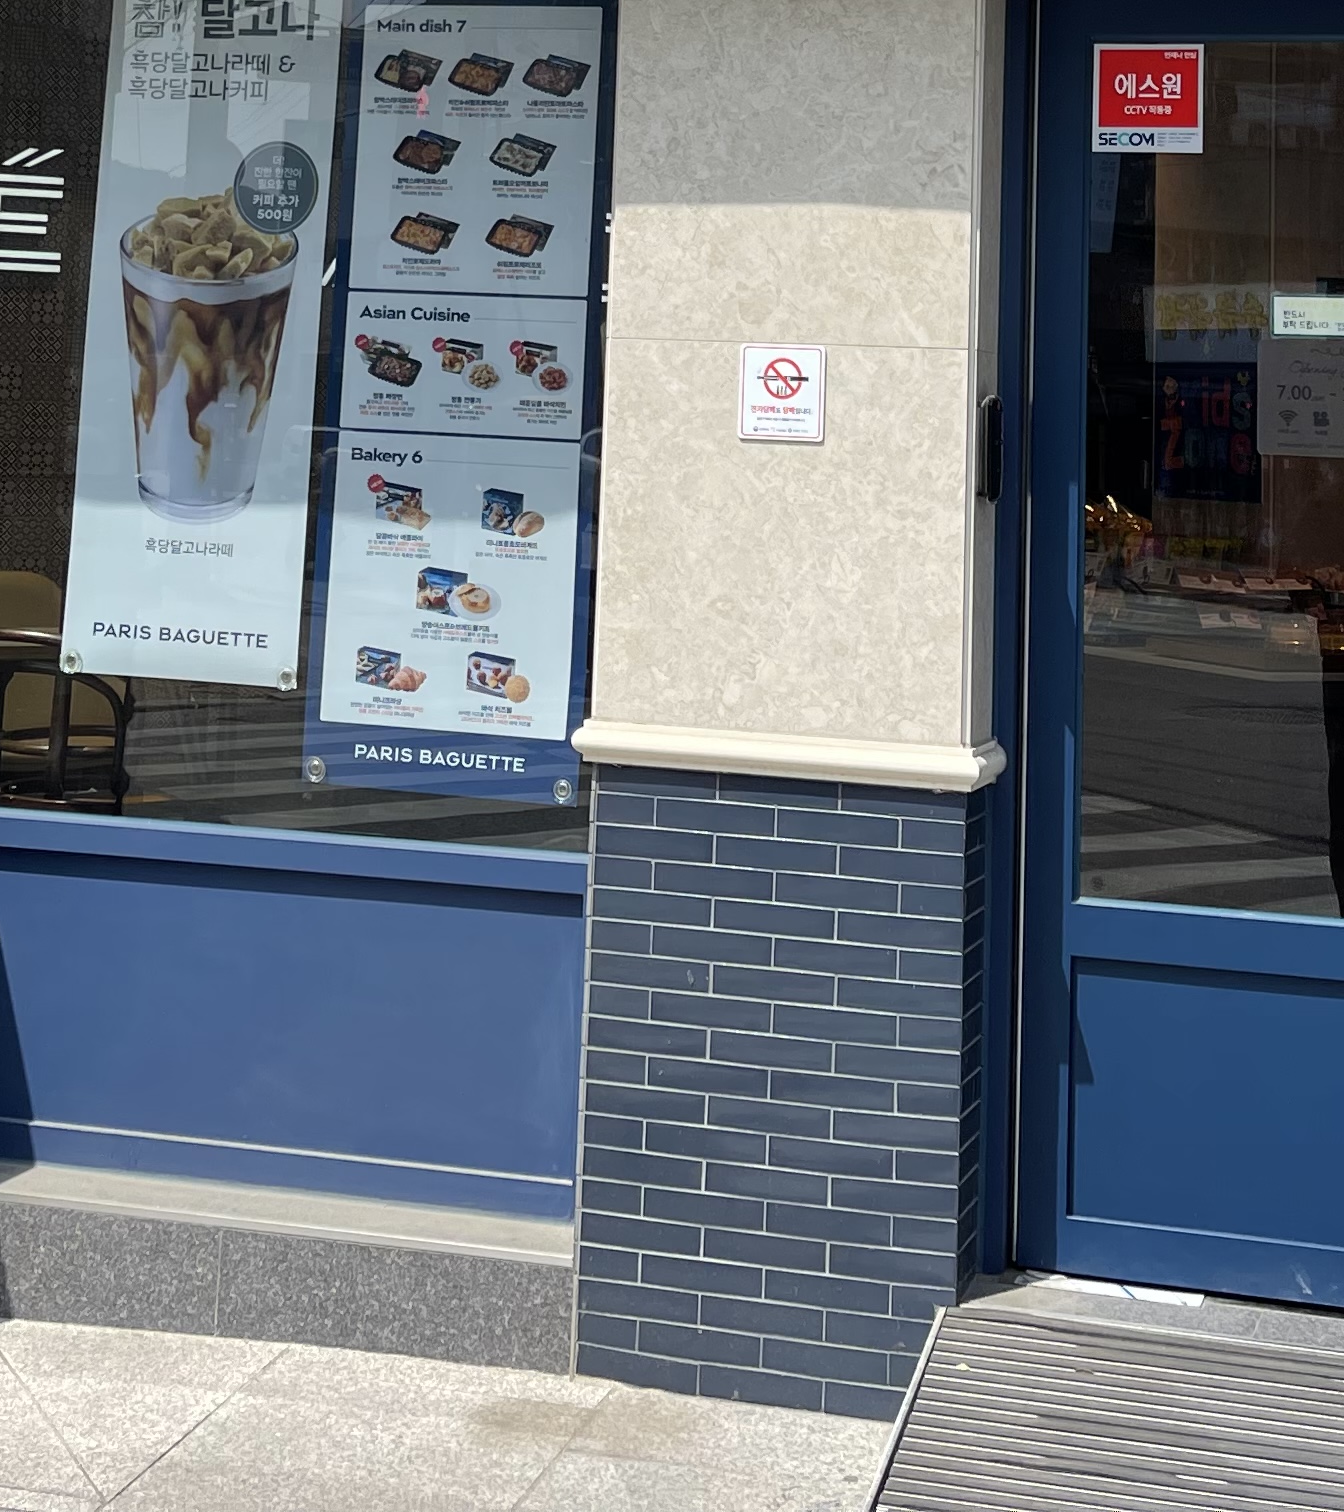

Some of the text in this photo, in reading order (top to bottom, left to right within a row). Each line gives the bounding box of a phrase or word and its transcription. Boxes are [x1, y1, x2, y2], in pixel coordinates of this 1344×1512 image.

[376, 19, 467, 34] Main dish 7
[129, 49, 296, 76] 흑당달고나라떼 &
[127, 75, 269, 102] 흑당달고나커피
[1114, 73, 1182, 99] 에스원
[1124, 105, 1148, 116] CCTV
[1098, 132, 1156, 147] SECOM
[252, 194, 300, 208] 커피 추가
[256, 209, 293, 223] 500원
[359, 304, 472, 323] Asian Cuisine
[1276, 384, 1312, 401] 7.00
[351, 447, 423, 467] Bakery 6
[144, 537, 234, 558] 흑당달고나라떼
[92, 621, 269, 649] PARIS BAGUETTE
[353, 742, 527, 774] PARIS BAGUETTE
